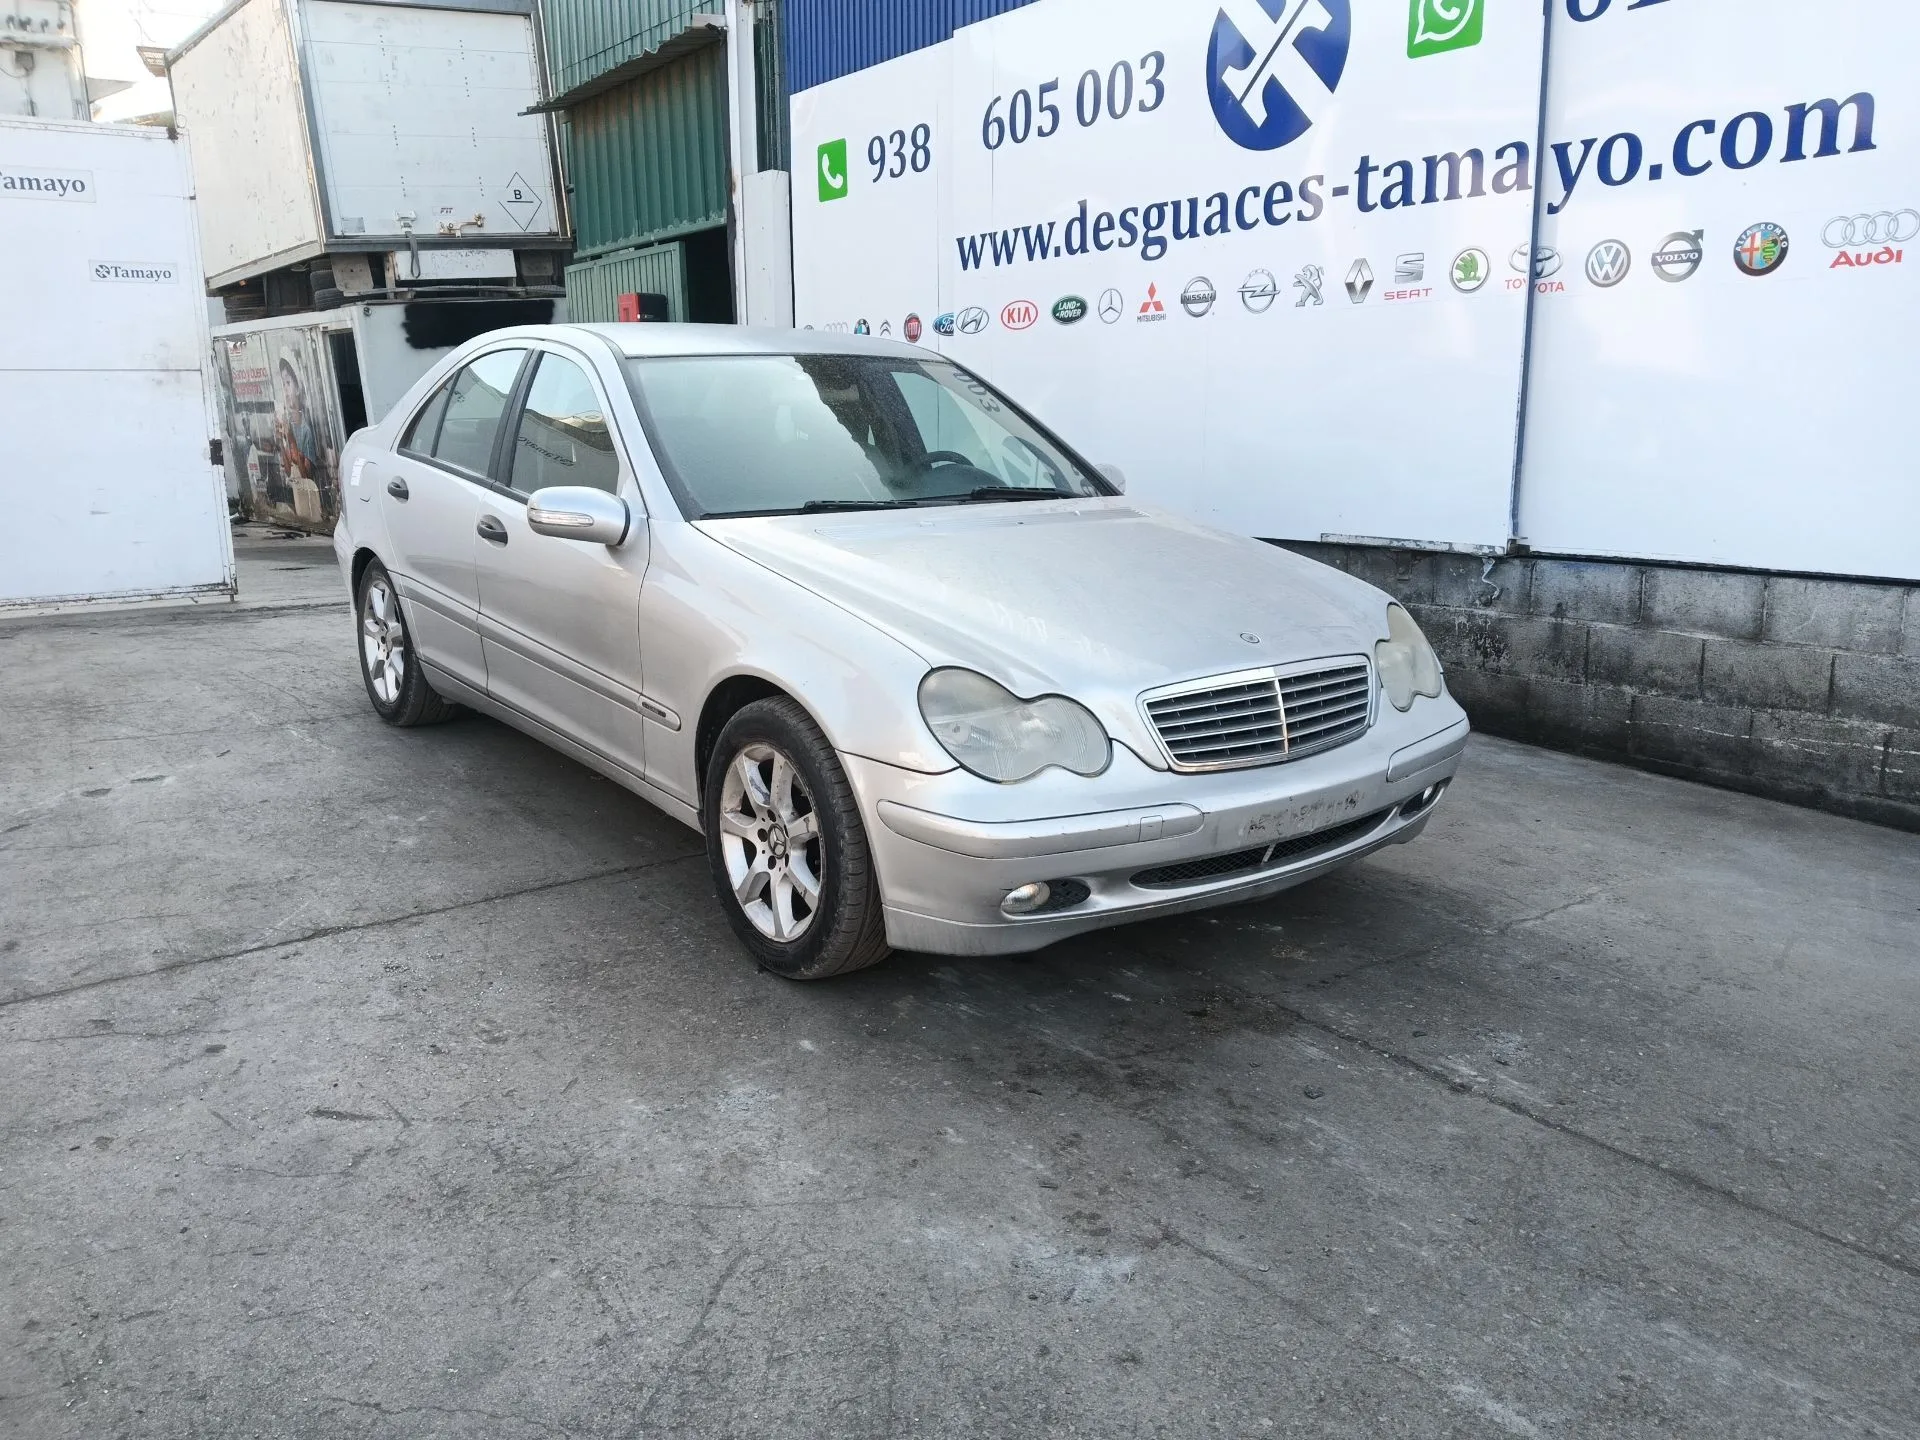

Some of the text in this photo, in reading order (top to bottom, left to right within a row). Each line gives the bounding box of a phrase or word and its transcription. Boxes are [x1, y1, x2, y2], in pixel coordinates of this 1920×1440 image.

[867, 50, 1166, 184] 938 605 003
[0, 171, 86, 197] amayo
[956, 91, 1877, 272] www.desguaces-tamayo.com
[513, 189, 523, 200] B
[1760, 223, 1788, 248] ROMEO
[1655, 251, 1699, 262] VOLVO
[110, 265, 172, 282] Tamayo
[1183, 293, 1214, 301] NISSAN
[1384, 287, 1433, 301] SEAT
[1007, 306, 1032, 324] KIA
[1059, 308, 1082, 318] ROVER
[1137, 313, 1167, 323] MITSUBISHI
